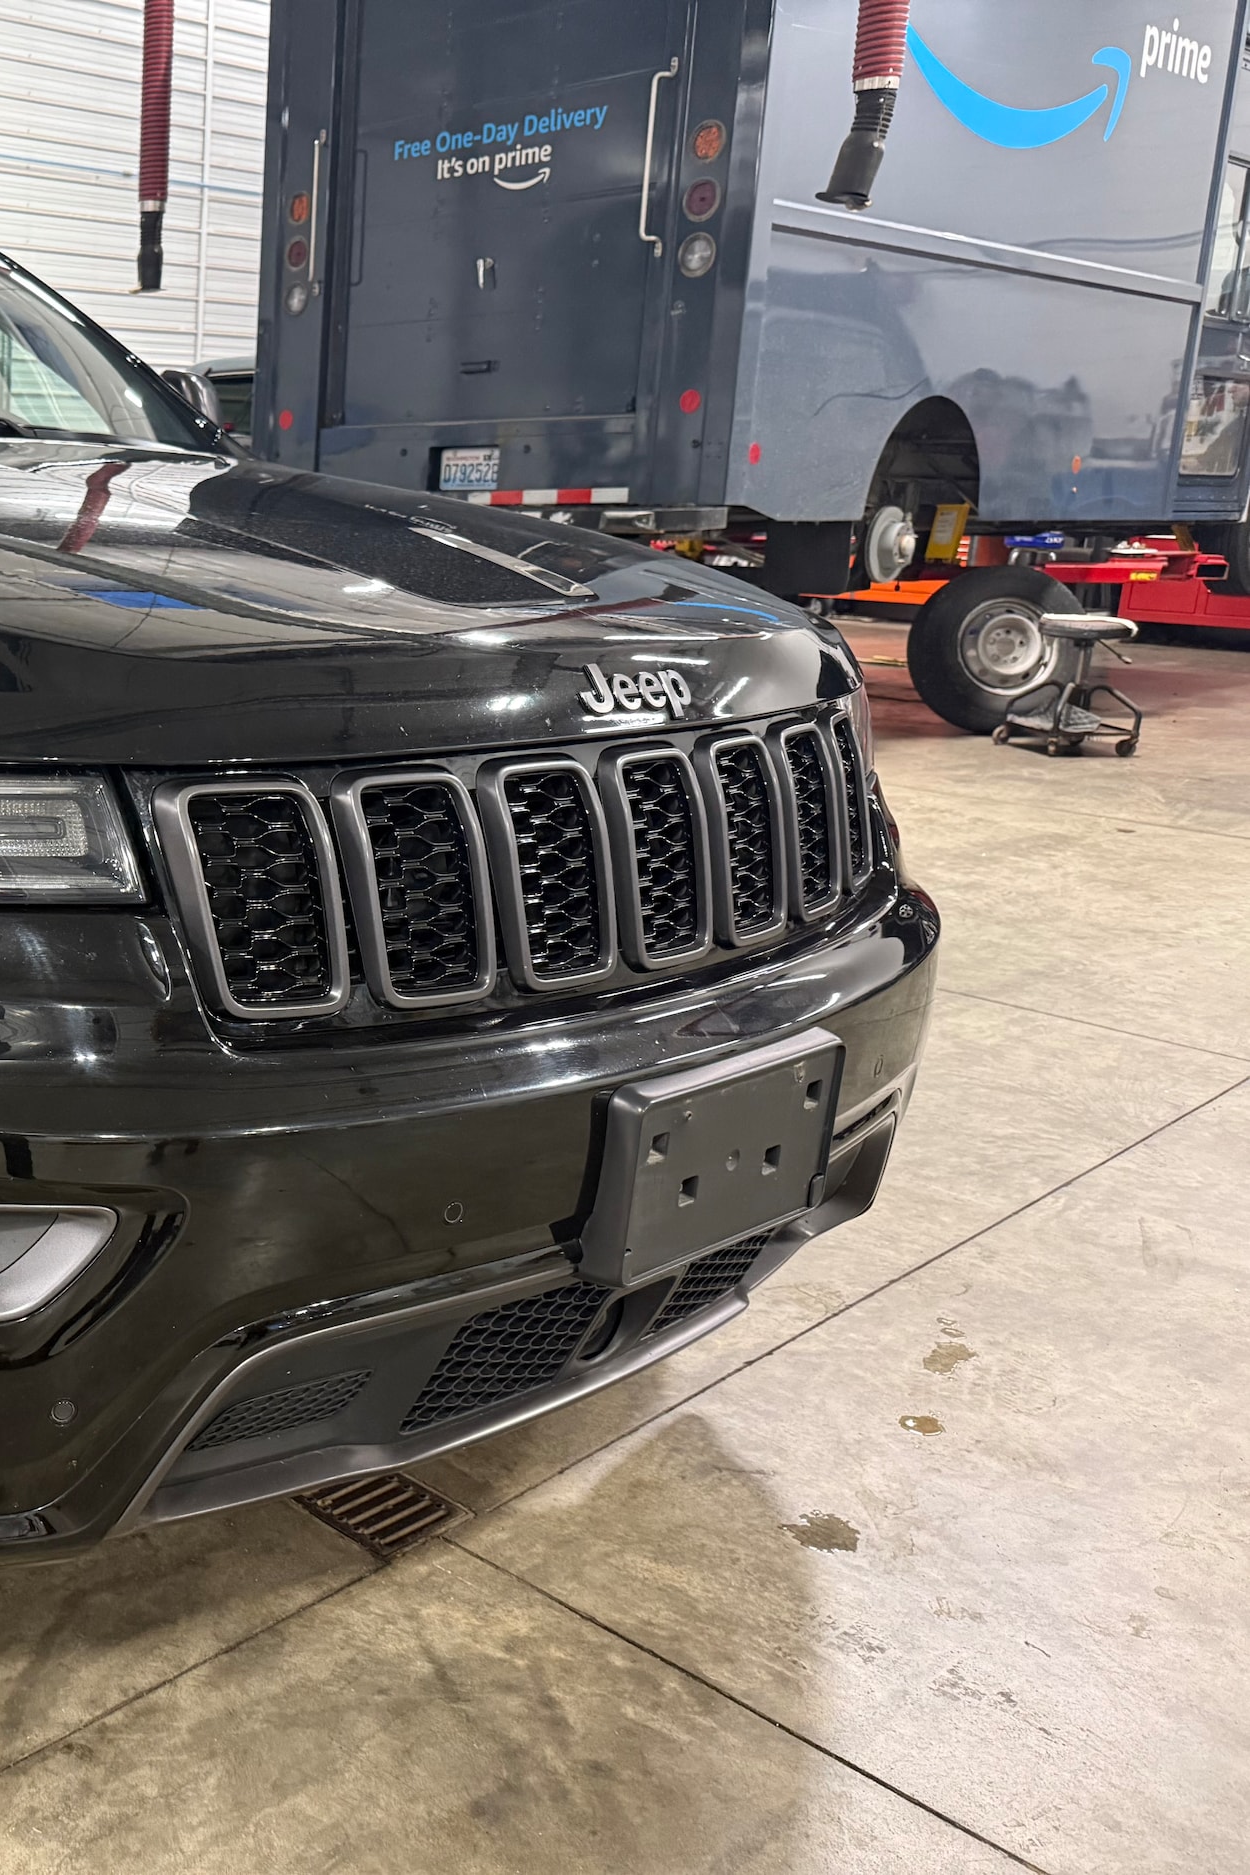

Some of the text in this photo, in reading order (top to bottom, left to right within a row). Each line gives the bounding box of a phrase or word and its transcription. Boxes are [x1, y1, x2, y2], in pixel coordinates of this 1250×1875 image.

[1139, 17, 1212, 84] prime
[393, 104, 608, 161] Free One-Day Delivery
[436, 143, 553, 181] It's on prime
[577, 663, 692, 719] Jeep
